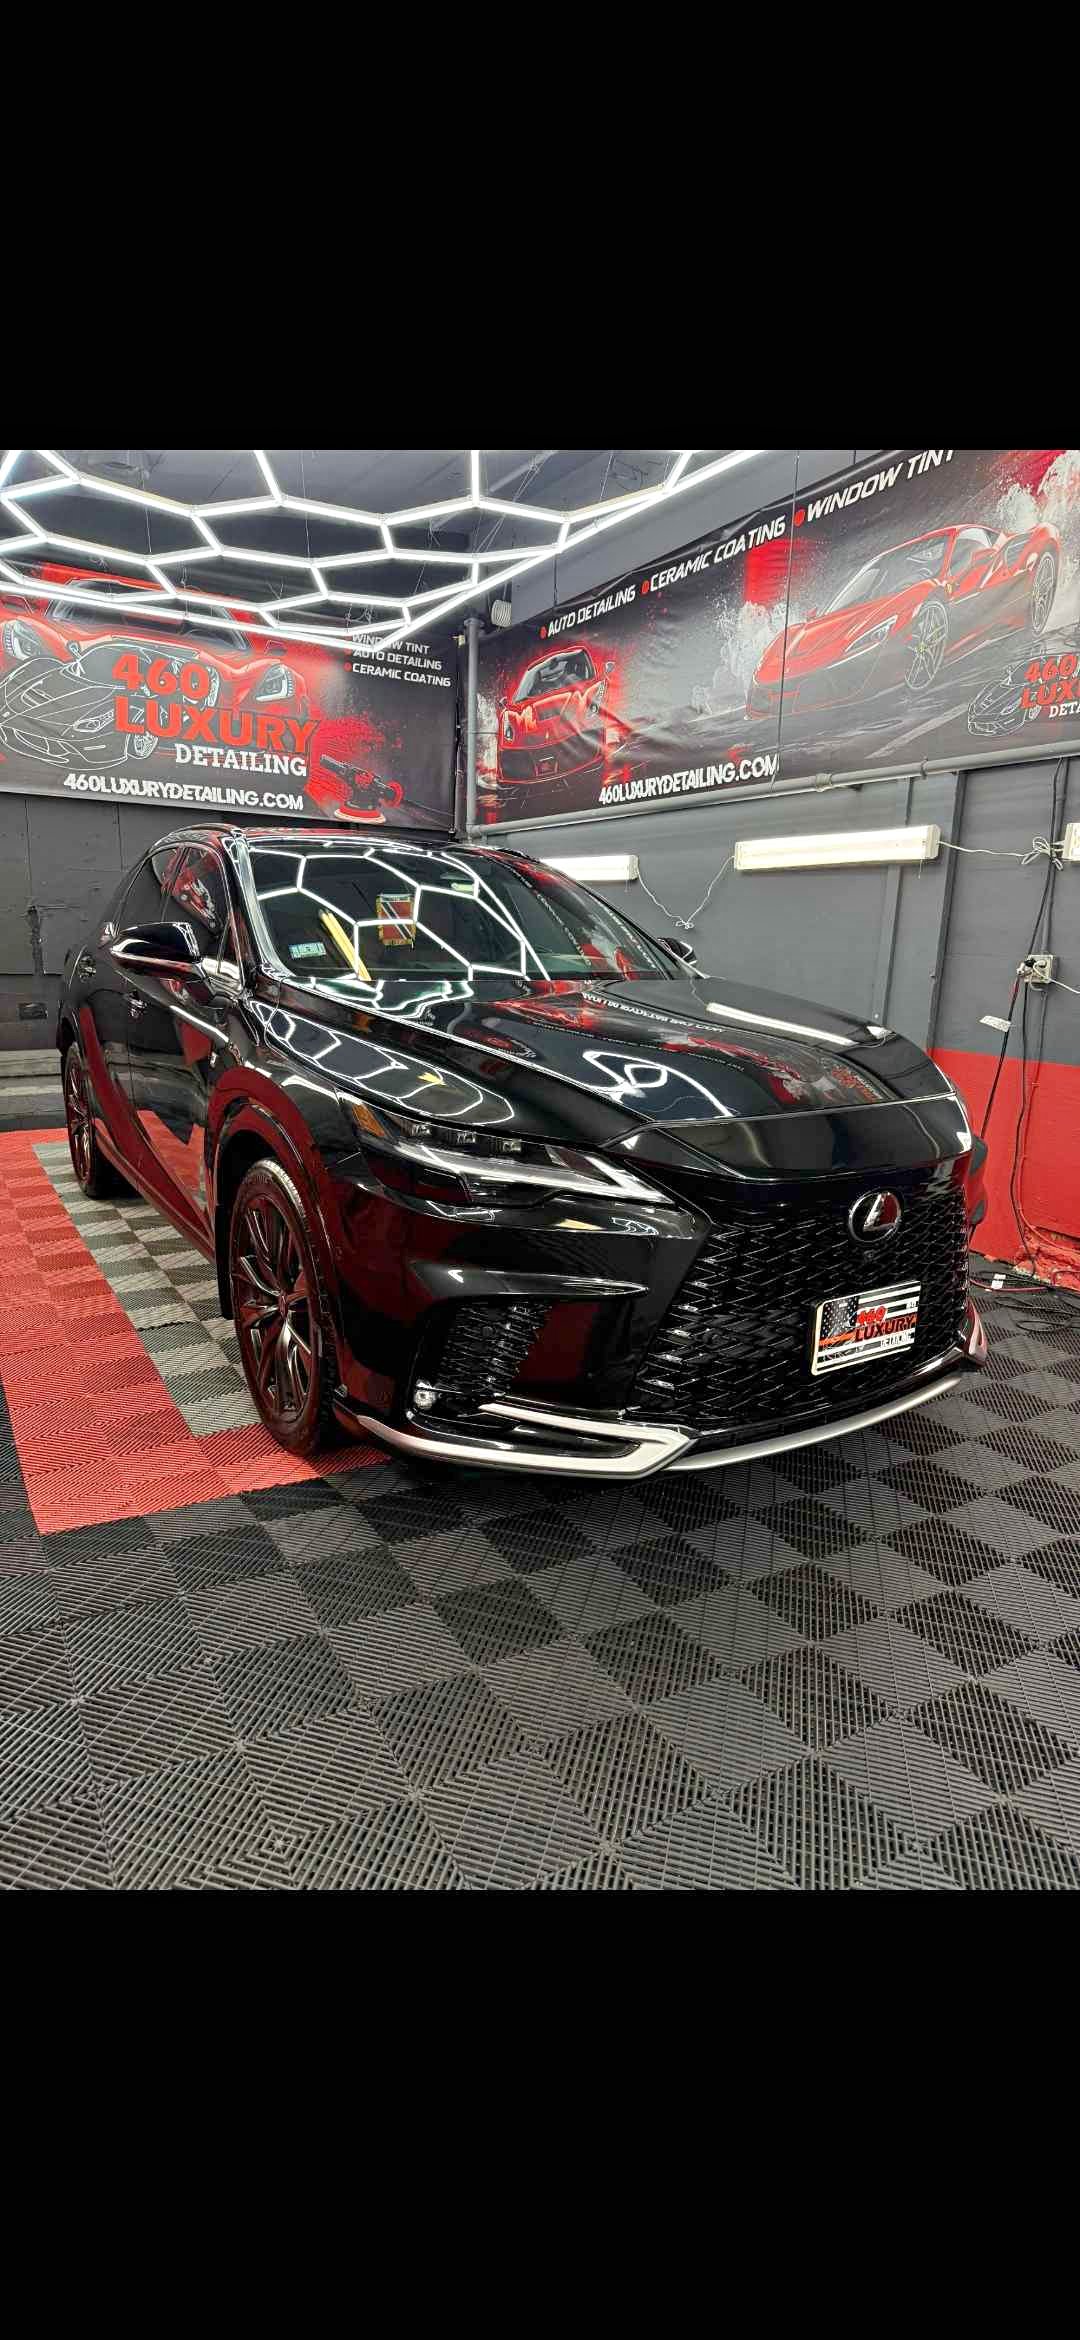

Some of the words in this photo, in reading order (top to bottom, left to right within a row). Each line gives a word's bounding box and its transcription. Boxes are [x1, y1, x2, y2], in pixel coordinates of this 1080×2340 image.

[547, 611, 577, 638] AUTO
[577, 584, 636, 625] DETAILING
[650, 550, 713, 592] CERAMIC
[714, 515, 786, 564] COATING
[807, 462, 904, 523] WINDOW
[353, 648, 385, 662] AUTO
[387, 652, 442, 670] DETAILING
[405, 641, 431, 655] TINT
[112, 653, 210, 700] 460
[352, 662, 402, 680] CERAMIC
[404, 671, 451, 687] COATING
[1024, 654, 1077, 683] 460
[113, 695, 318, 753] LUXURY
[174, 742, 307, 777] DETAILING
[63, 773, 304, 811] 460LUXURYDETAILING.COM
[598, 753, 780, 805] 460LUXURYDETAILING.COM
[854, 1315, 916, 1342] LUXURY
